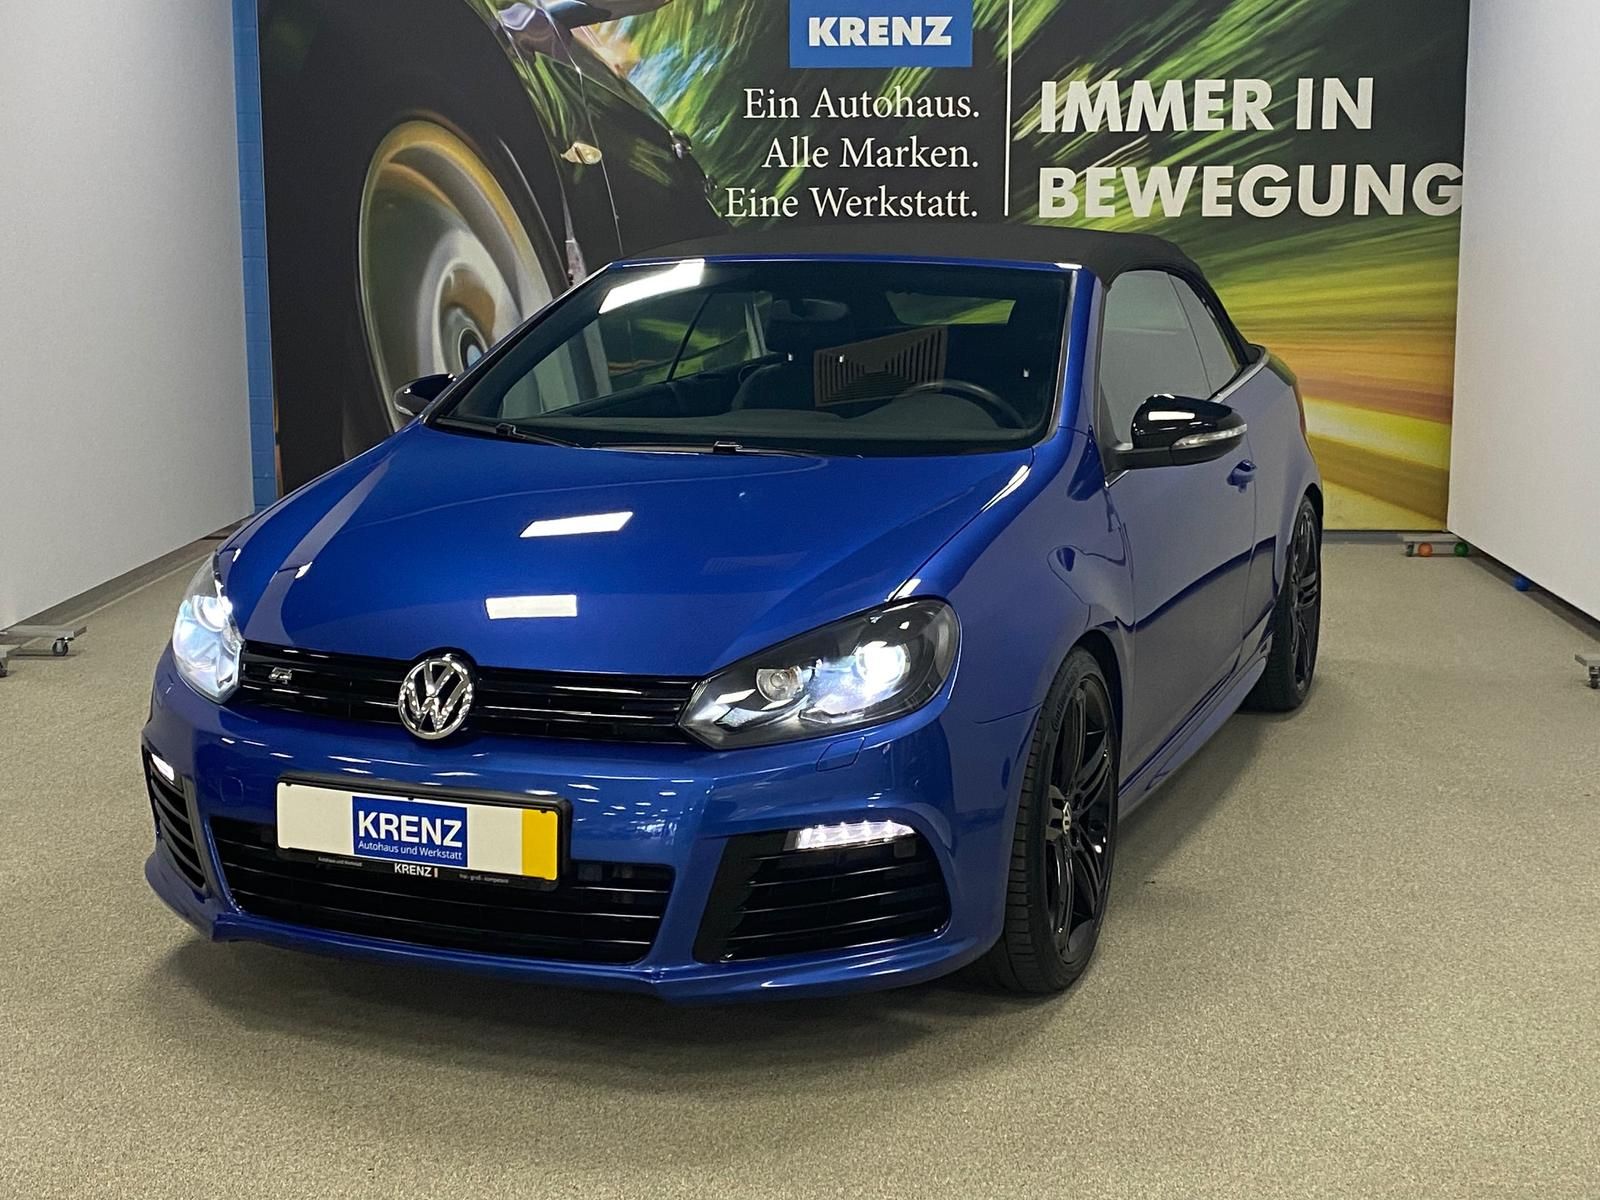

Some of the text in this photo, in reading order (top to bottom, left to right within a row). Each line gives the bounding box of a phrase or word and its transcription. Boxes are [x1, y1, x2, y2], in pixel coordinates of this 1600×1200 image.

[807, 16, 953, 47] KRENZ
[743, 86, 980, 119] Ein Autohaus.
[1040, 77, 1374, 133] IMMER IN
[761, 135, 979, 169] Alle Marken.
[724, 185, 978, 218] Eine Werkstatt.
[1038, 162, 1464, 219] BEWEGUNG
[358, 810, 463, 848] KRENZ
[358, 840, 463, 861] Autohaus und Werkstatt
[394, 862, 432, 878] KRENZ
